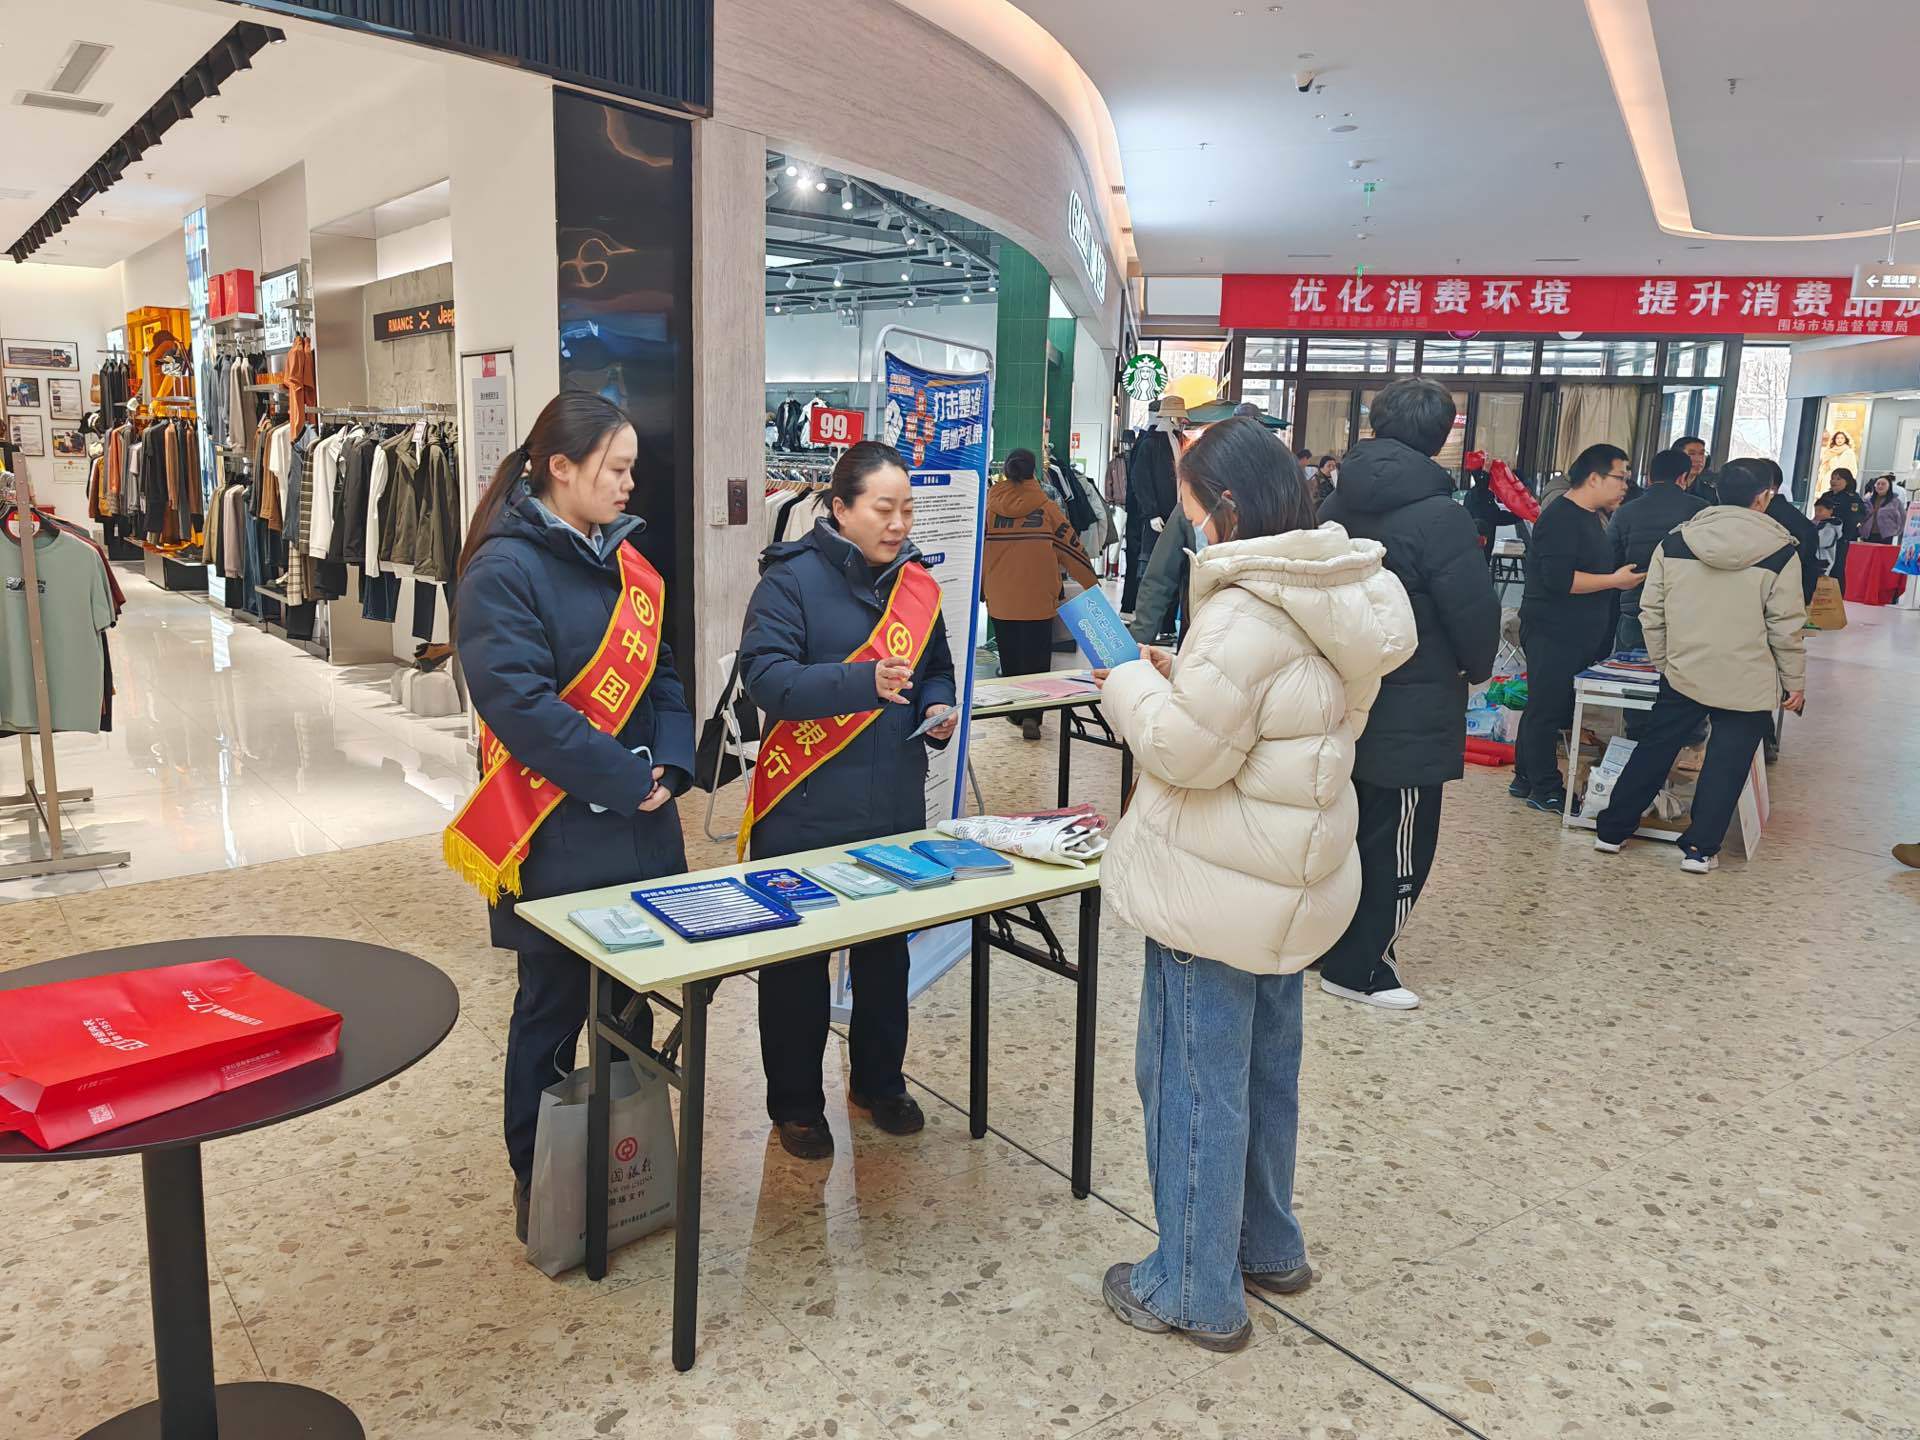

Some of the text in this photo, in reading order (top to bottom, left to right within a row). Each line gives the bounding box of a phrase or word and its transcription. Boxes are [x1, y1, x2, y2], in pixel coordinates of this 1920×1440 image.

[1290, 278, 1571, 315] 优化消费环境
[1778, 319, 1908, 333] 围场市场监督管理局
[610, 1157, 653, 1183] 国银行
